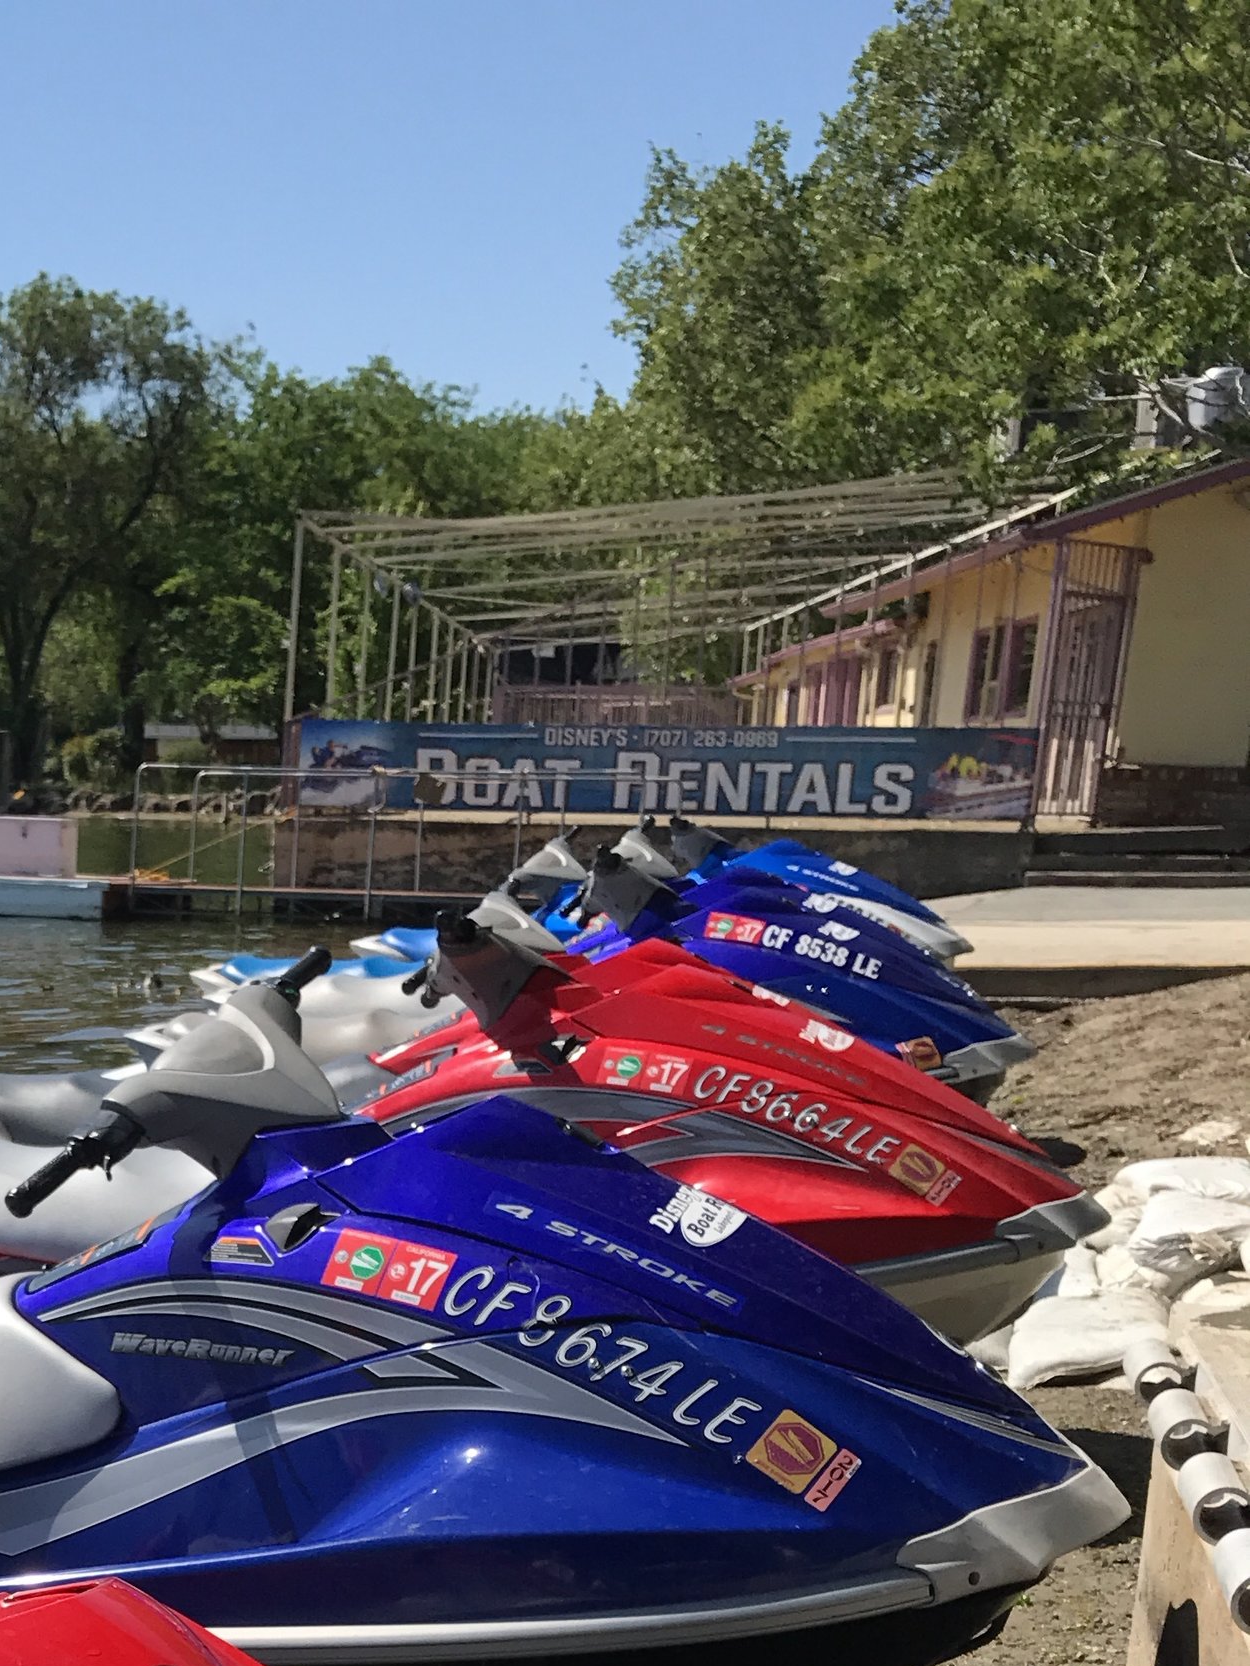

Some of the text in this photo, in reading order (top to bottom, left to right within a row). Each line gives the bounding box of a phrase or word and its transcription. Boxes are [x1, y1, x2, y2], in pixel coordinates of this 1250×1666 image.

[543, 726, 628, 748] DISNEY'S
[416, 747, 918, 816] BOAT RENTALS
[762, 923, 794, 950] CF
[794, 934, 850, 967] 8538
[851, 953, 883, 980] LE
[660, 1061, 690, 1087] 17
[686, 1206, 719, 1238] Boat
[495, 1203, 534, 1221] 4
[545, 1218, 738, 1308] STROKE
[409, 1257, 449, 1296] 17
[110, 1331, 295, 1367] WaveRunner
